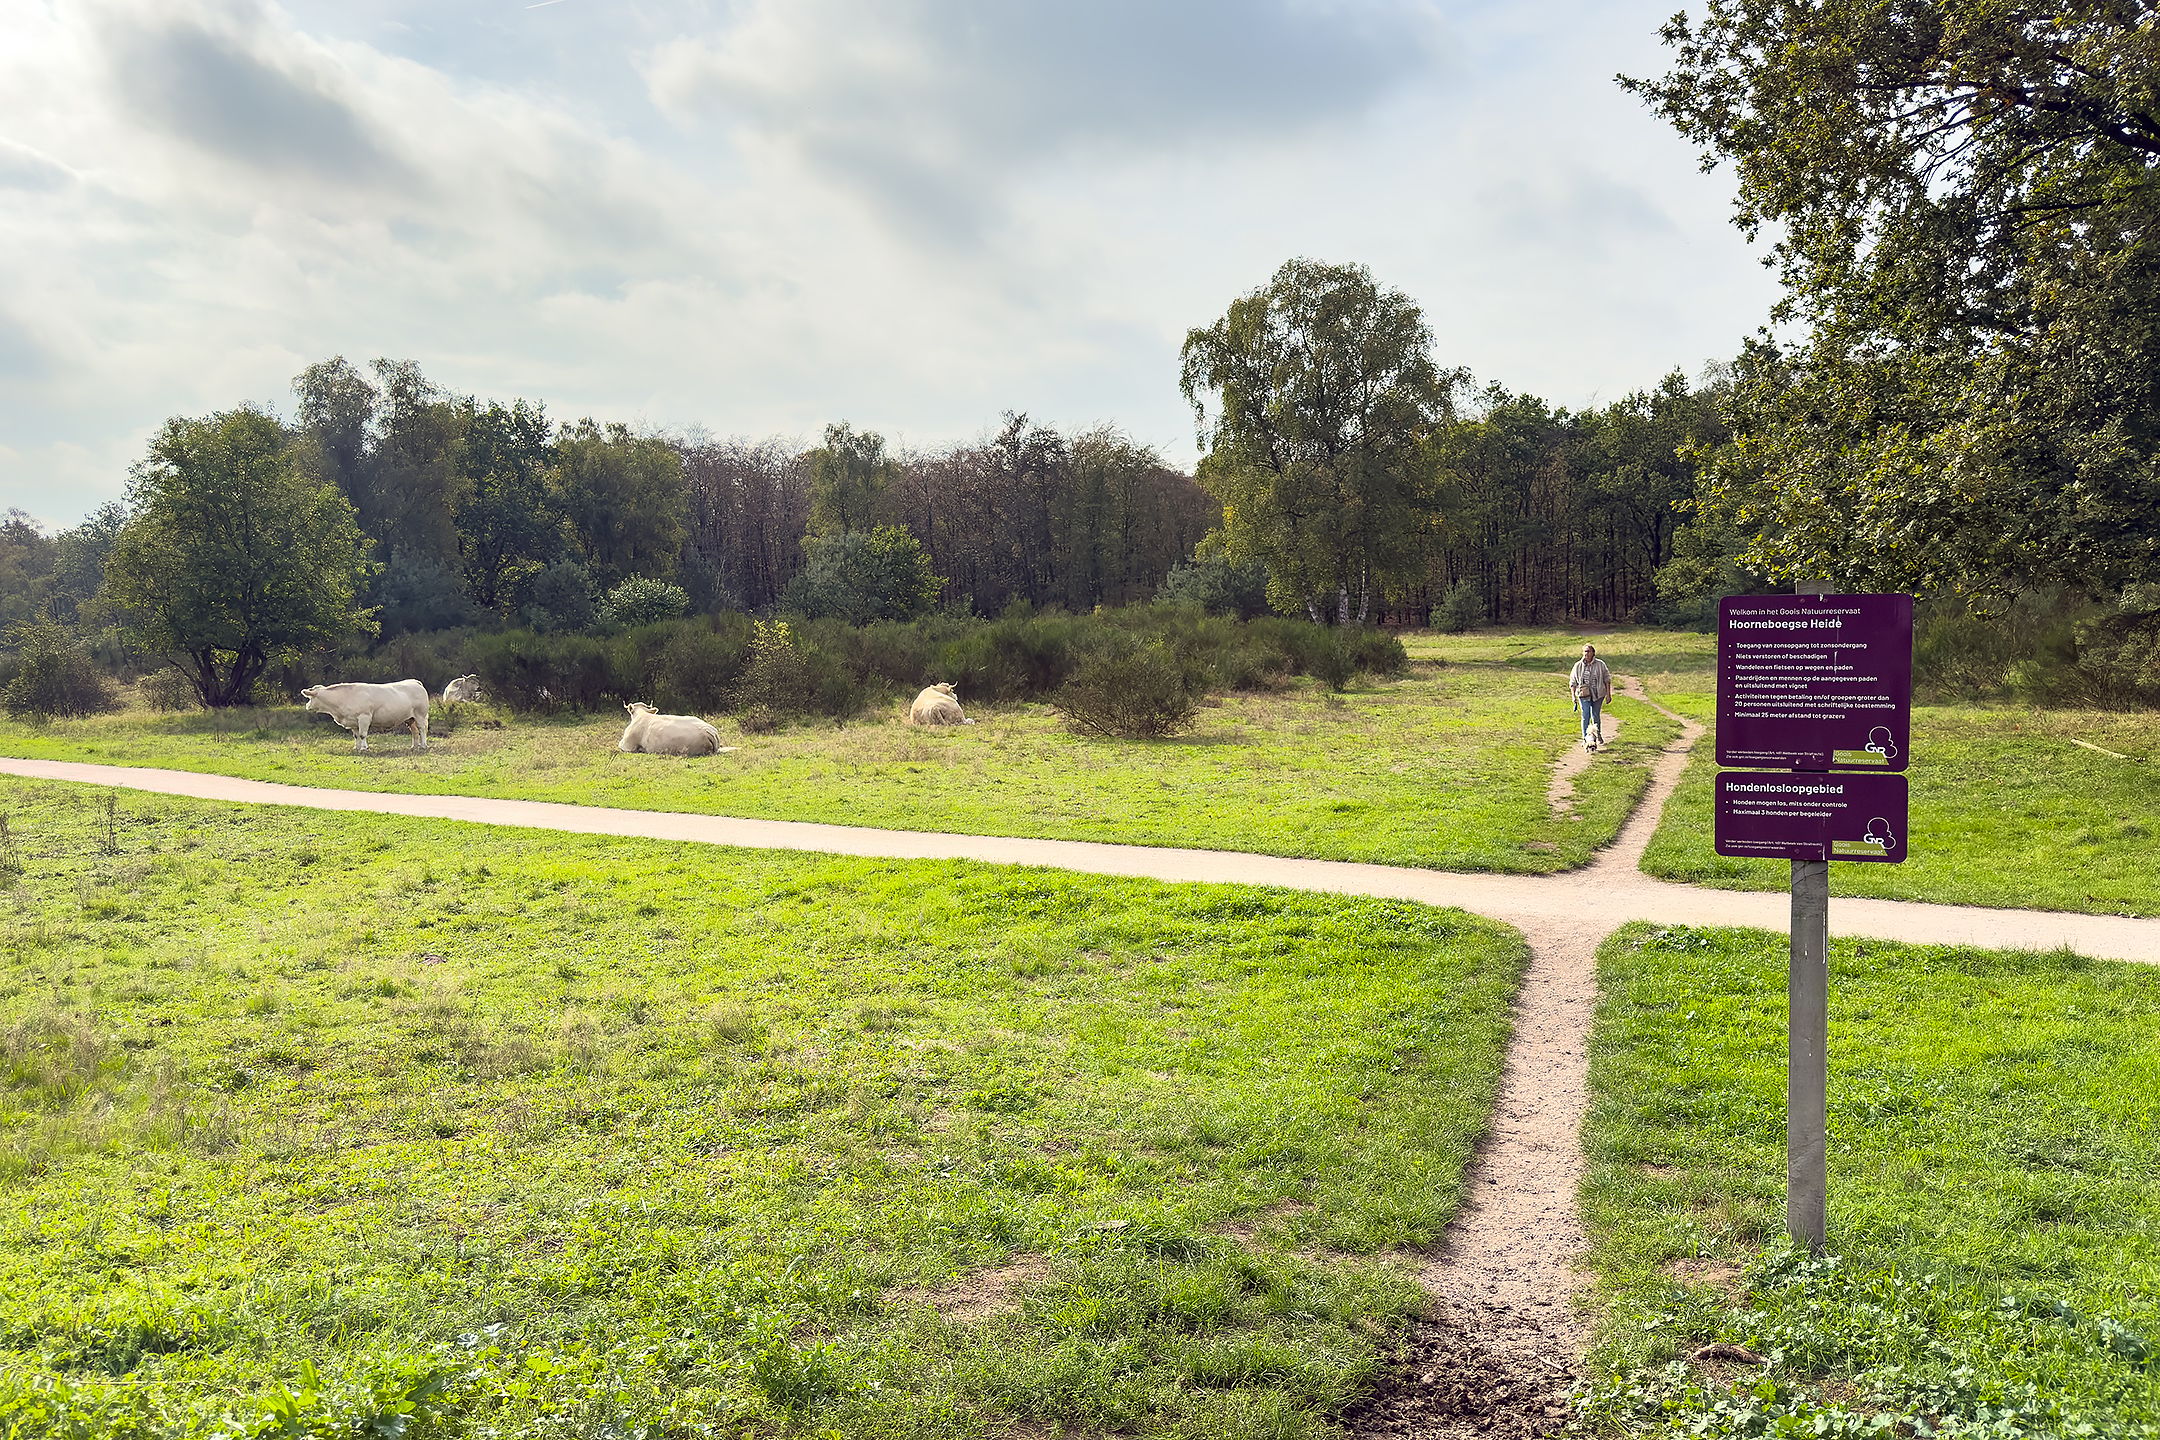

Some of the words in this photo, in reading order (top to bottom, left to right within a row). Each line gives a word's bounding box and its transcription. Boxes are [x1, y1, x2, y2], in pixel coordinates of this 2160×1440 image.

[1730, 620, 1808, 630] Hoorneboegse
[1810, 619, 1842, 628] Heide
[1865, 742, 1886, 754] GNR
[1726, 782, 1843, 795] Hondenlosloopgebied
[1864, 834, 1884, 844] GNR
